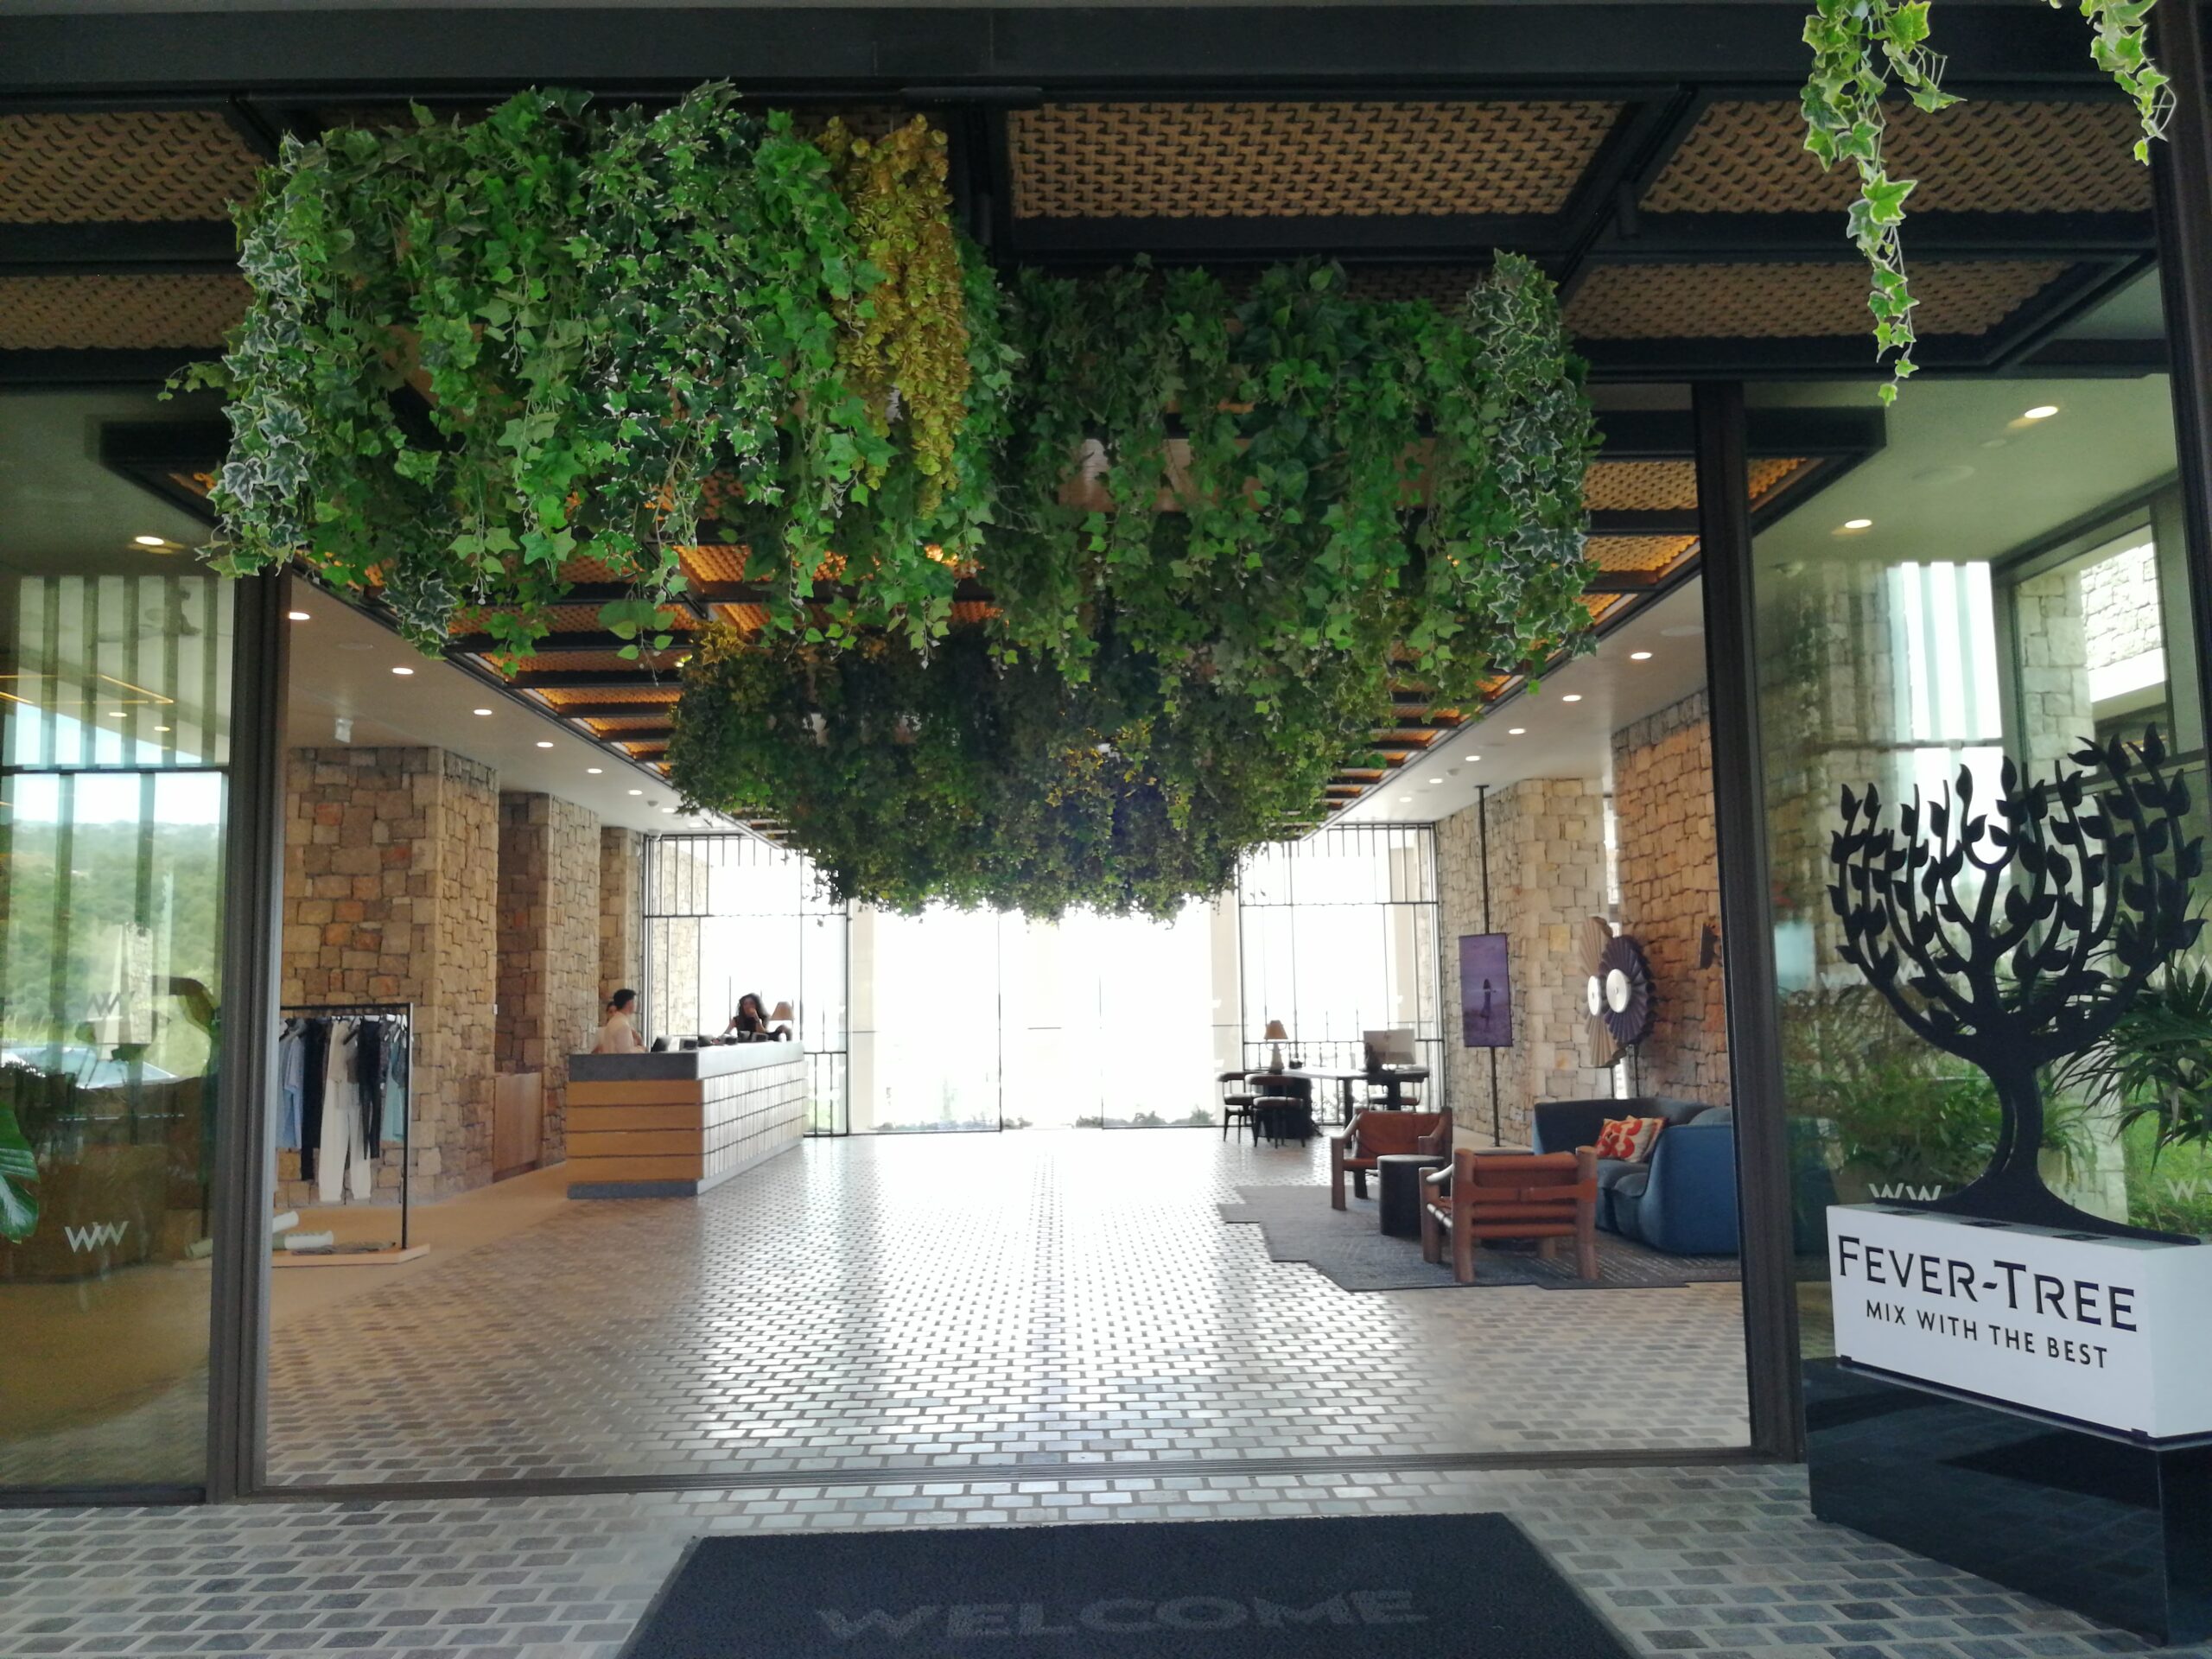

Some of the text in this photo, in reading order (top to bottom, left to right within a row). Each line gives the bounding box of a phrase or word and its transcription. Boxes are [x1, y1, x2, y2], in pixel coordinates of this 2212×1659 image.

[1838, 1235, 2138, 1332] FEVER-TREE
[1866, 1299, 2108, 1369] MIX WITH THE BEST
[817, 1589, 1428, 1639] WELCOME
